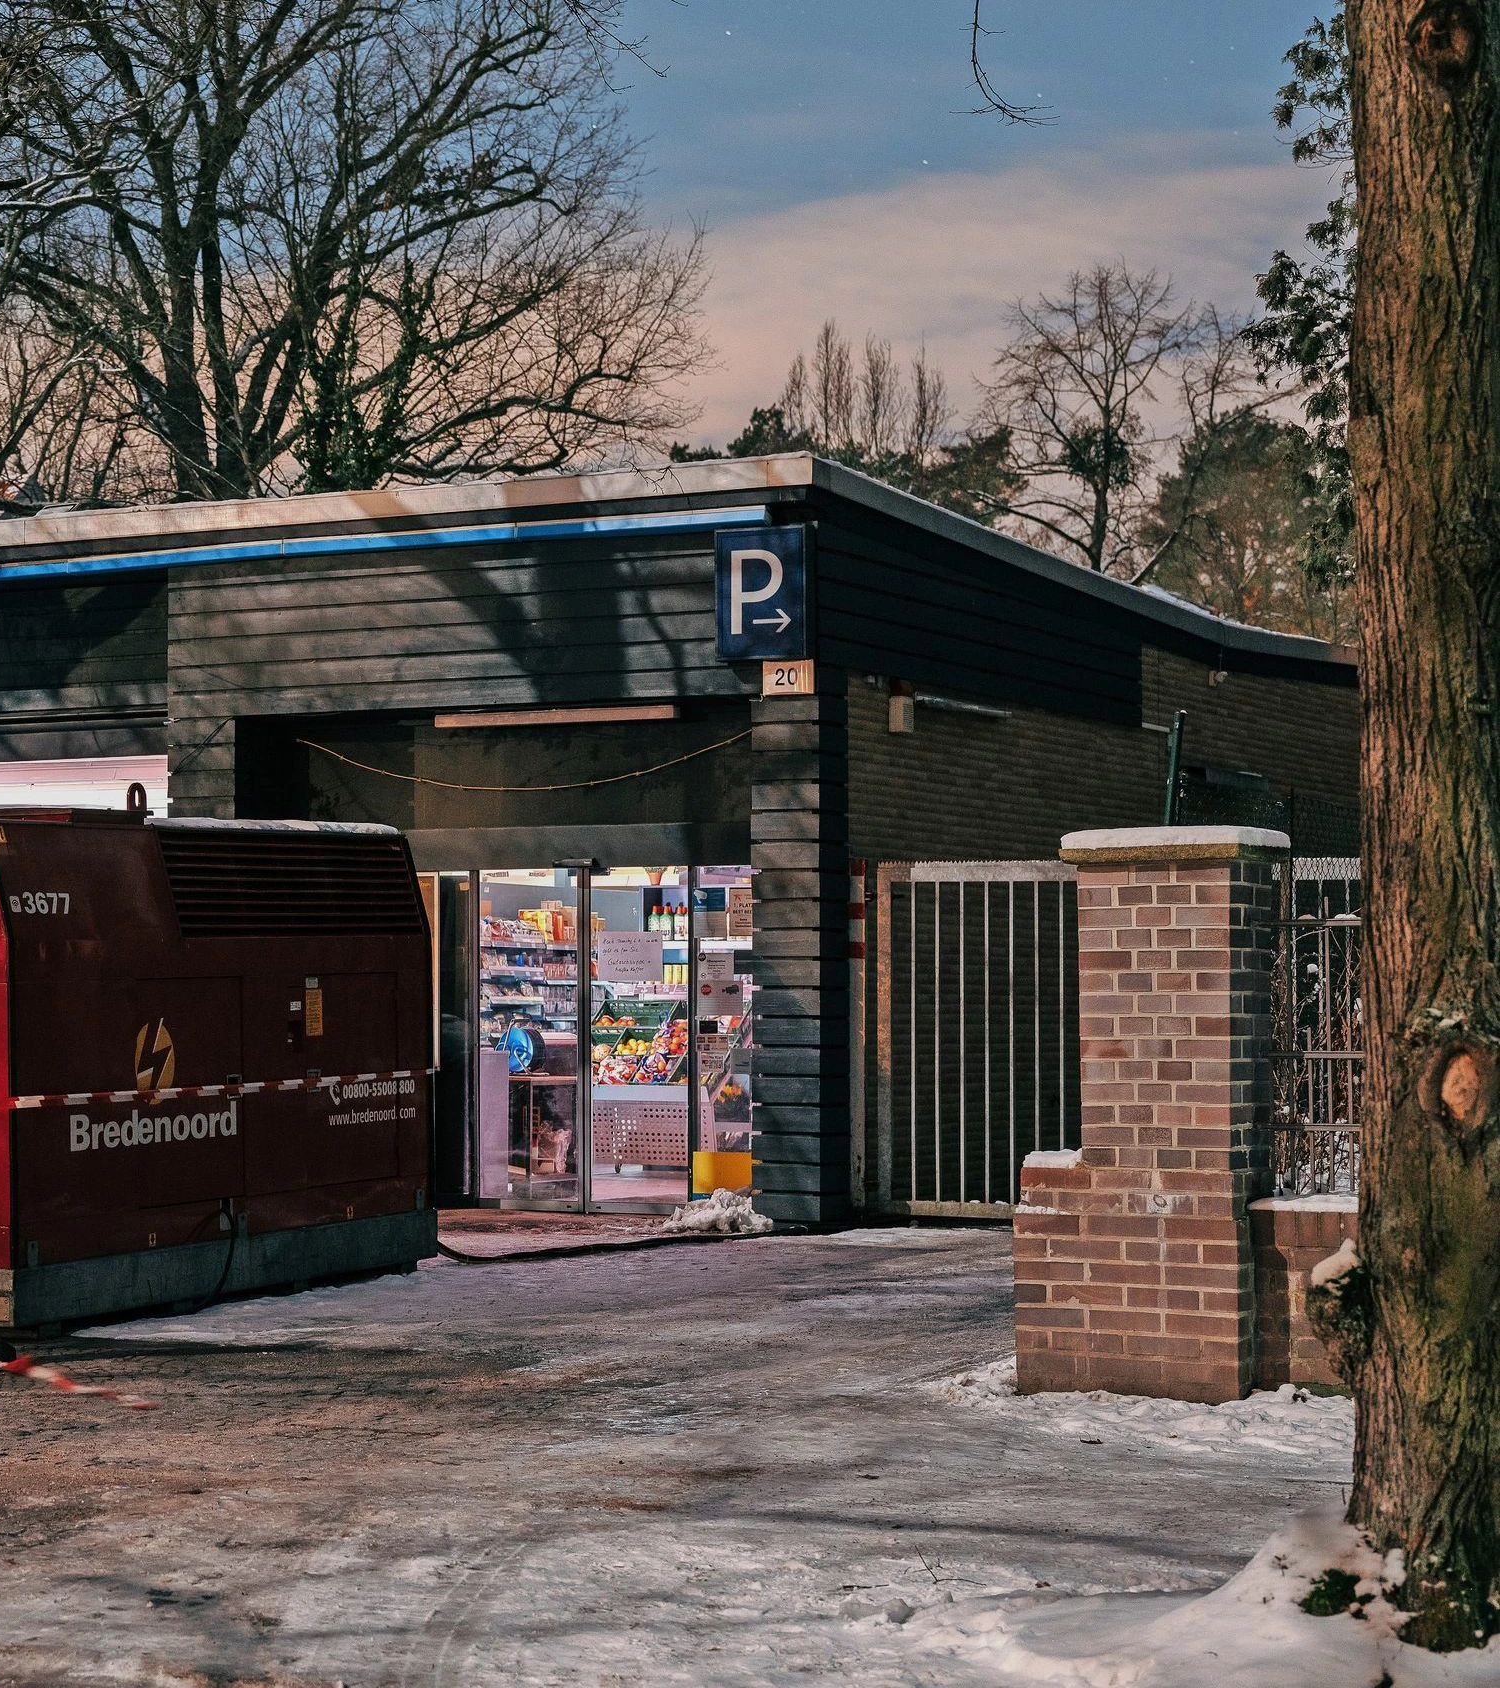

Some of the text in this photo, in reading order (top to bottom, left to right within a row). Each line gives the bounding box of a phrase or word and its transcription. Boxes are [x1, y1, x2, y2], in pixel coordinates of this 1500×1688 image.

[730, 549, 784, 635] P
[775, 667, 798, 686] 20
[22, 891, 70, 914] 3677
[69, 1100, 238, 1152] Bredenoord
